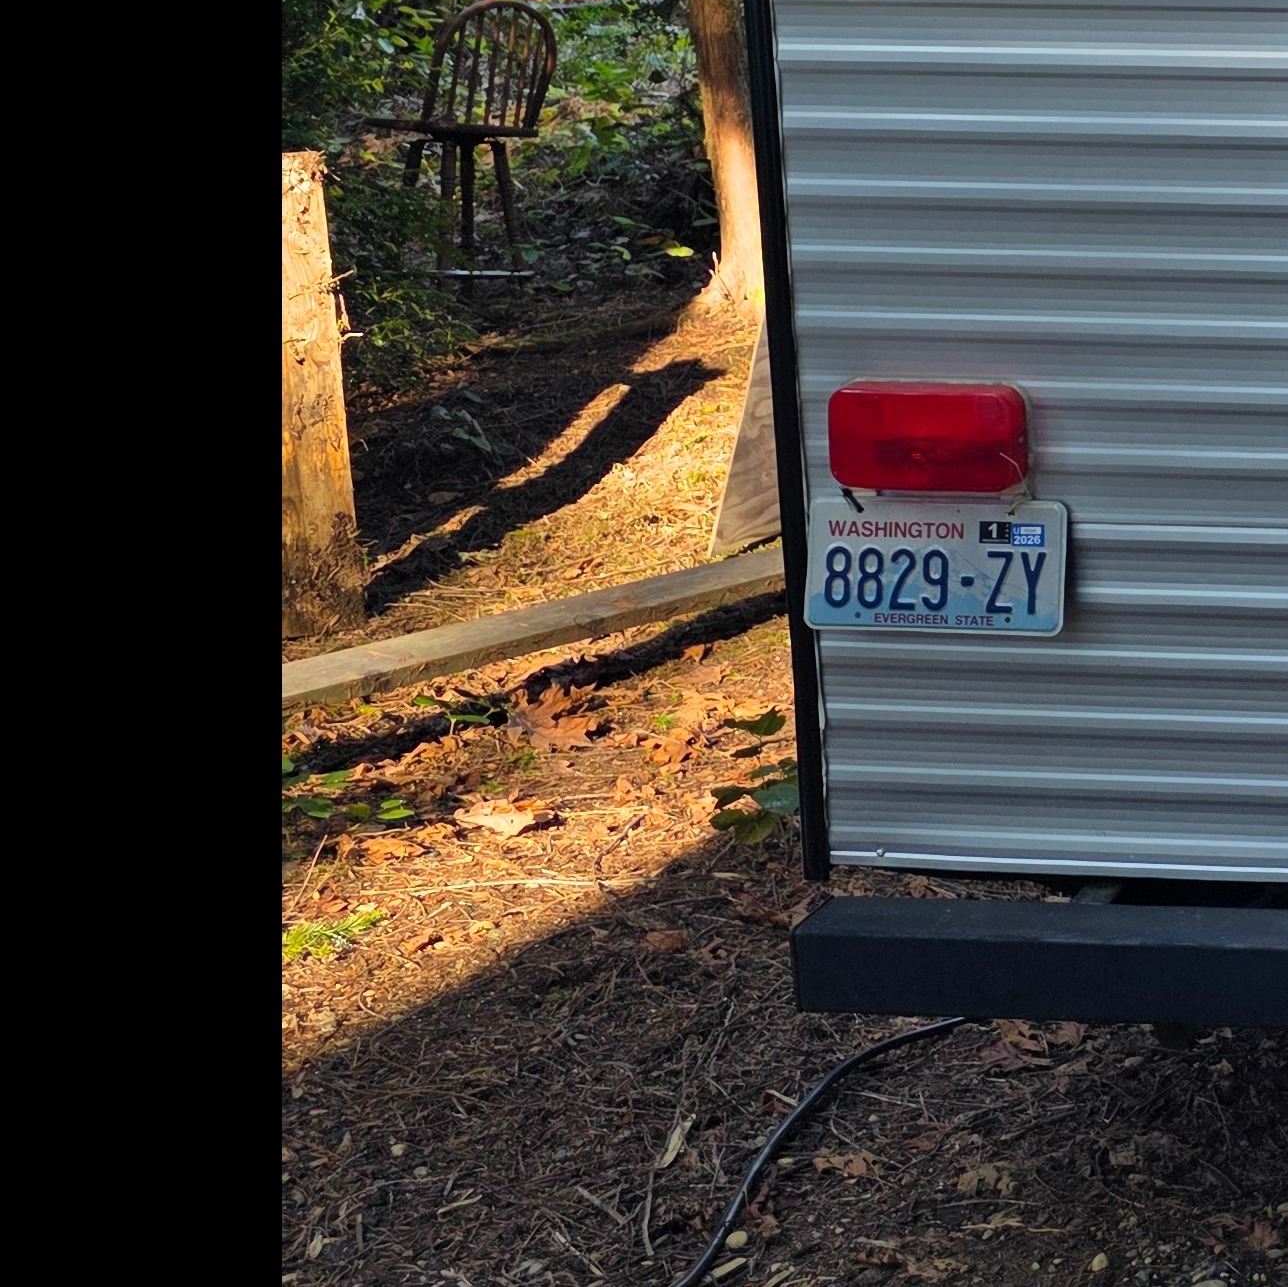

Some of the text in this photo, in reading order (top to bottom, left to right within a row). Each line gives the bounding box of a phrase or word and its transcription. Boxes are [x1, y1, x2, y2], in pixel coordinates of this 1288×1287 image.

[828, 519, 965, 540] WASHINGTON
[988, 522, 998, 539] 1
[1013, 535, 1042, 545] 2026
[824, 545, 1047, 616] 8829-ZY
[873, 612, 994, 627] EVERGREEN STATE
